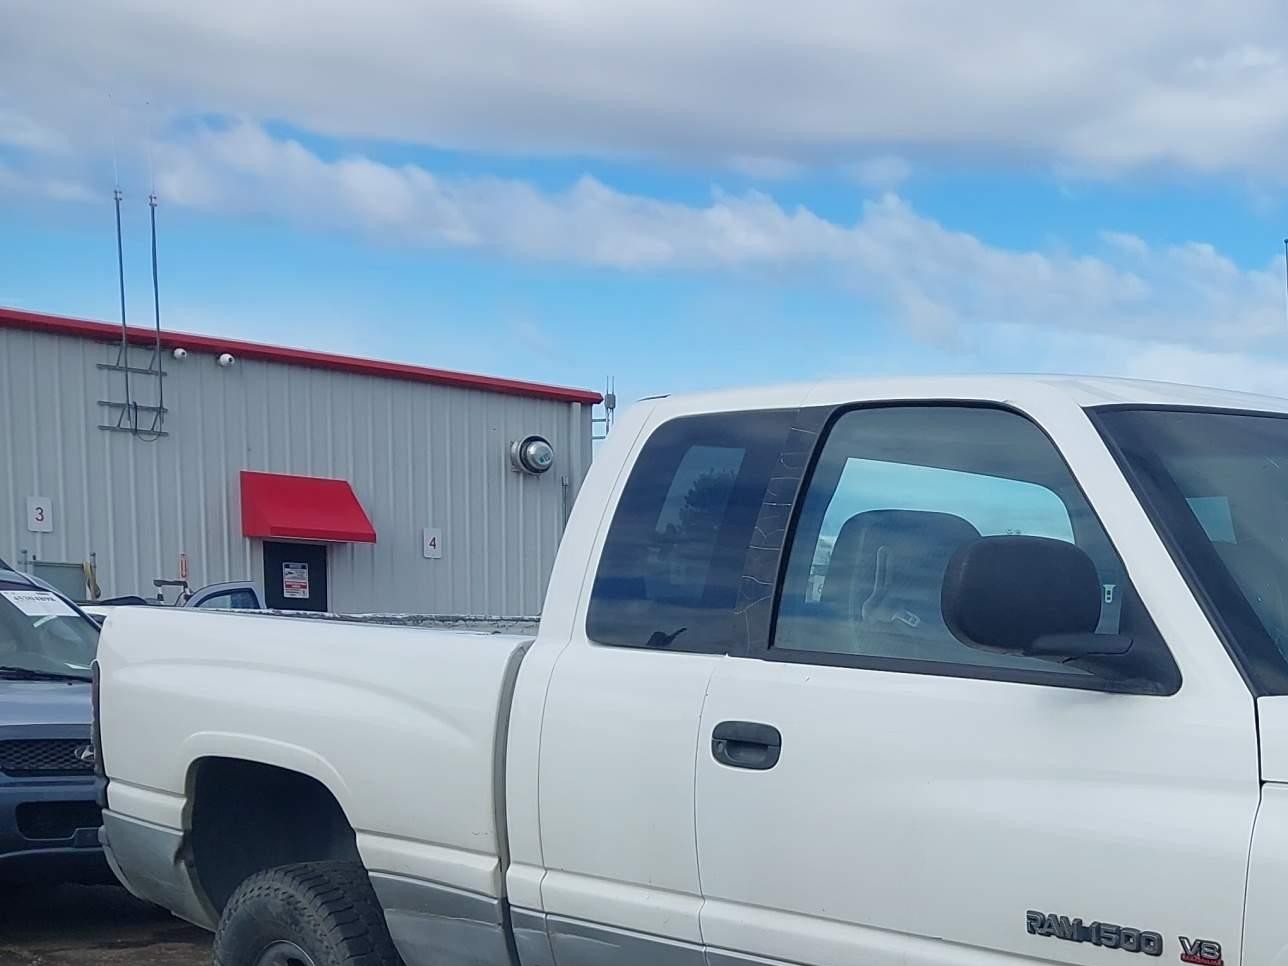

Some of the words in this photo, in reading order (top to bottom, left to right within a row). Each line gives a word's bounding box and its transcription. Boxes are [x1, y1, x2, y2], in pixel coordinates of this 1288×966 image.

[35, 507, 45, 522] 3
[429, 536, 437, 550] 4
[1026, 910, 1083, 943] RAM
[1089, 920, 1164, 957] 1500
[1179, 936, 1222, 962] V8
